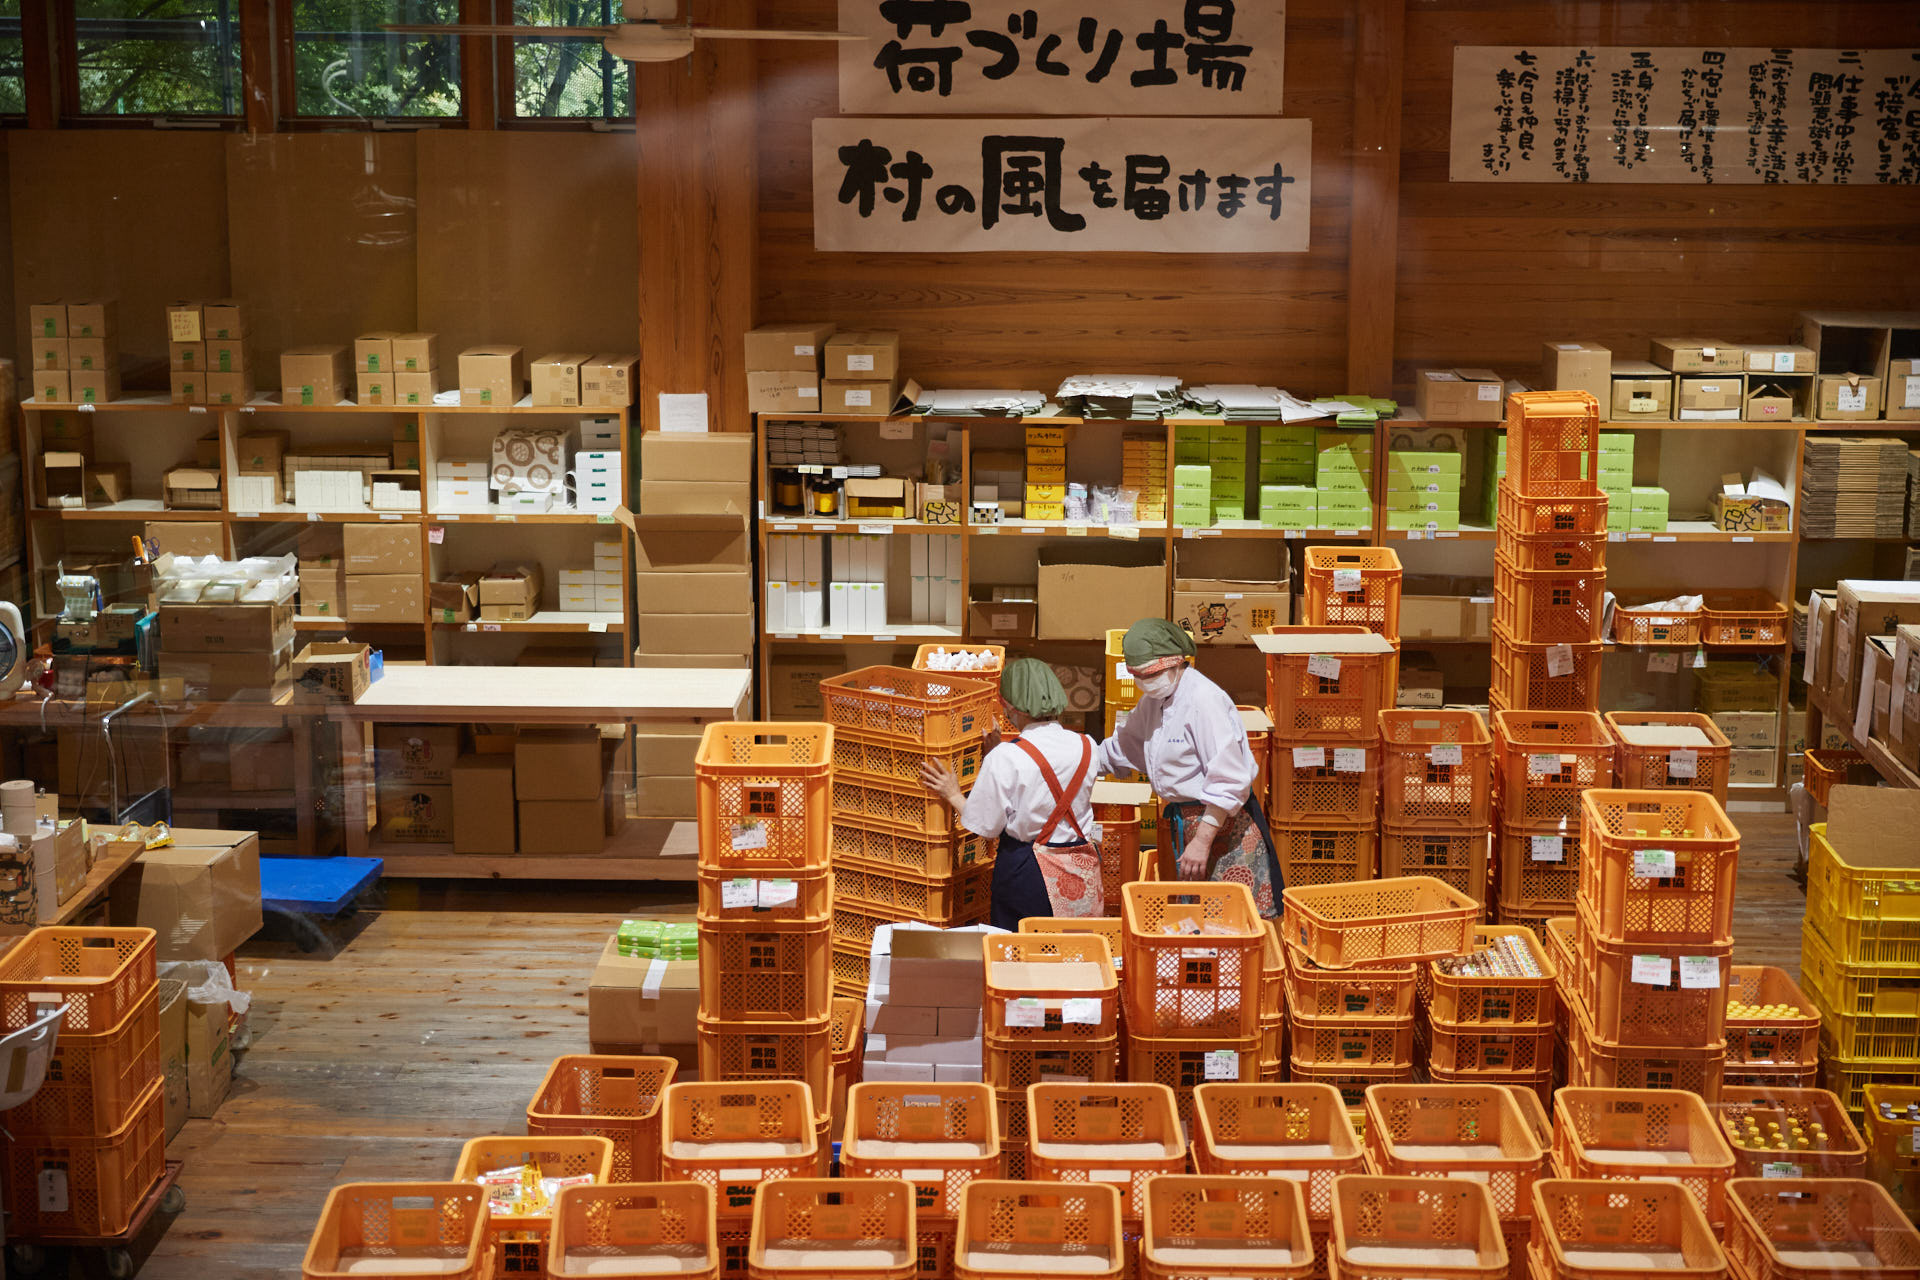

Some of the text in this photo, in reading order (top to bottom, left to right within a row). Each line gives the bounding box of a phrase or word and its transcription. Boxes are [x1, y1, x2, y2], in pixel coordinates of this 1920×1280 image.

[1514, 50, 1539, 161] 七、今日も仲良く
[838, 136, 1294, 232] 村の風を届けます
[749, 791, 775, 802] 馬路
[749, 803, 775, 813] 農協
[1186, 962, 1212, 972] 馬路
[1186, 973, 1212, 984] 農協
[505, 1244, 540, 1256] 馬路
[505, 1257, 540, 1272] 農協
